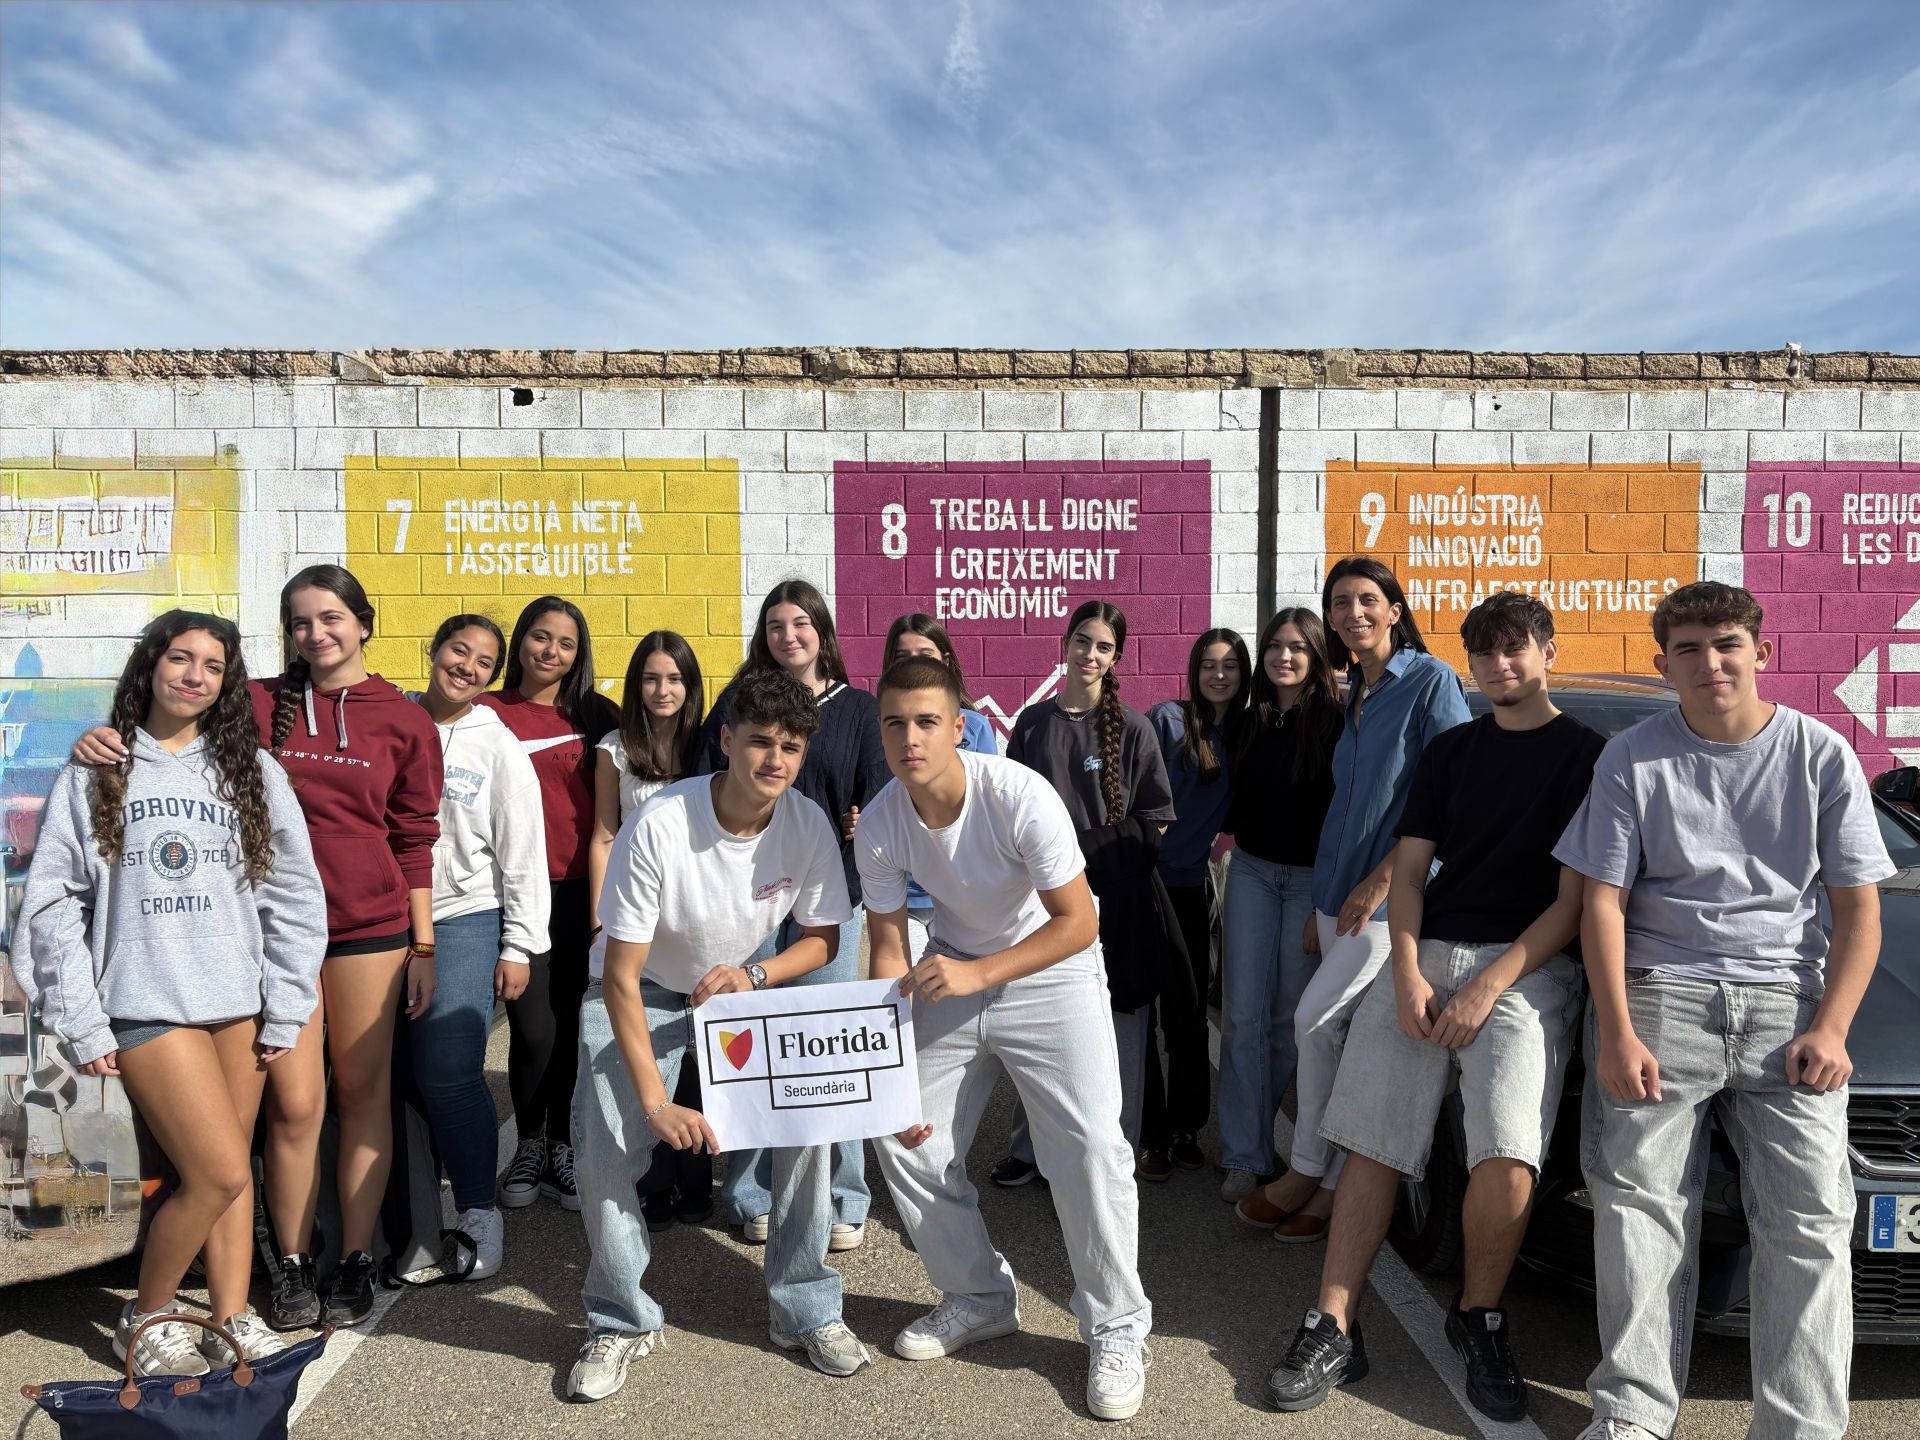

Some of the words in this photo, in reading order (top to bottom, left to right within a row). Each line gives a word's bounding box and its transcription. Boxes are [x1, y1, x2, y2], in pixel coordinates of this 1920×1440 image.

[444, 499, 562, 534] ENERGIA
[571, 499, 644, 534] NETA
[930, 498, 1053, 532] TREBALL
[1061, 498, 1138, 532] DIGNE
[1359, 491, 1386, 548] 9
[1408, 485, 1544, 527] INDÚSTRIA
[1763, 491, 1812, 548] 10
[1843, 492, 1920, 526] REDUC
[386, 498, 413, 553] 7
[881, 503, 908, 560] 8
[460, 541, 634, 578] ASSEQUIBLE
[935, 546, 942, 578] I
[950, 546, 1121, 581] CREIXEMENT
[1408, 526, 1543, 568] INNOVACIÓ
[1842, 532, 1892, 565] LES
[935, 580, 1068, 620] ECONÒMIC
[551, 752, 579, 762] AIR
[121, 850, 144, 867] EST
[141, 895, 213, 916] CROATIA
[777, 1026, 890, 1060] Florida
[784, 1080, 856, 1098] Secundària
[1879, 1227, 1889, 1240] E
